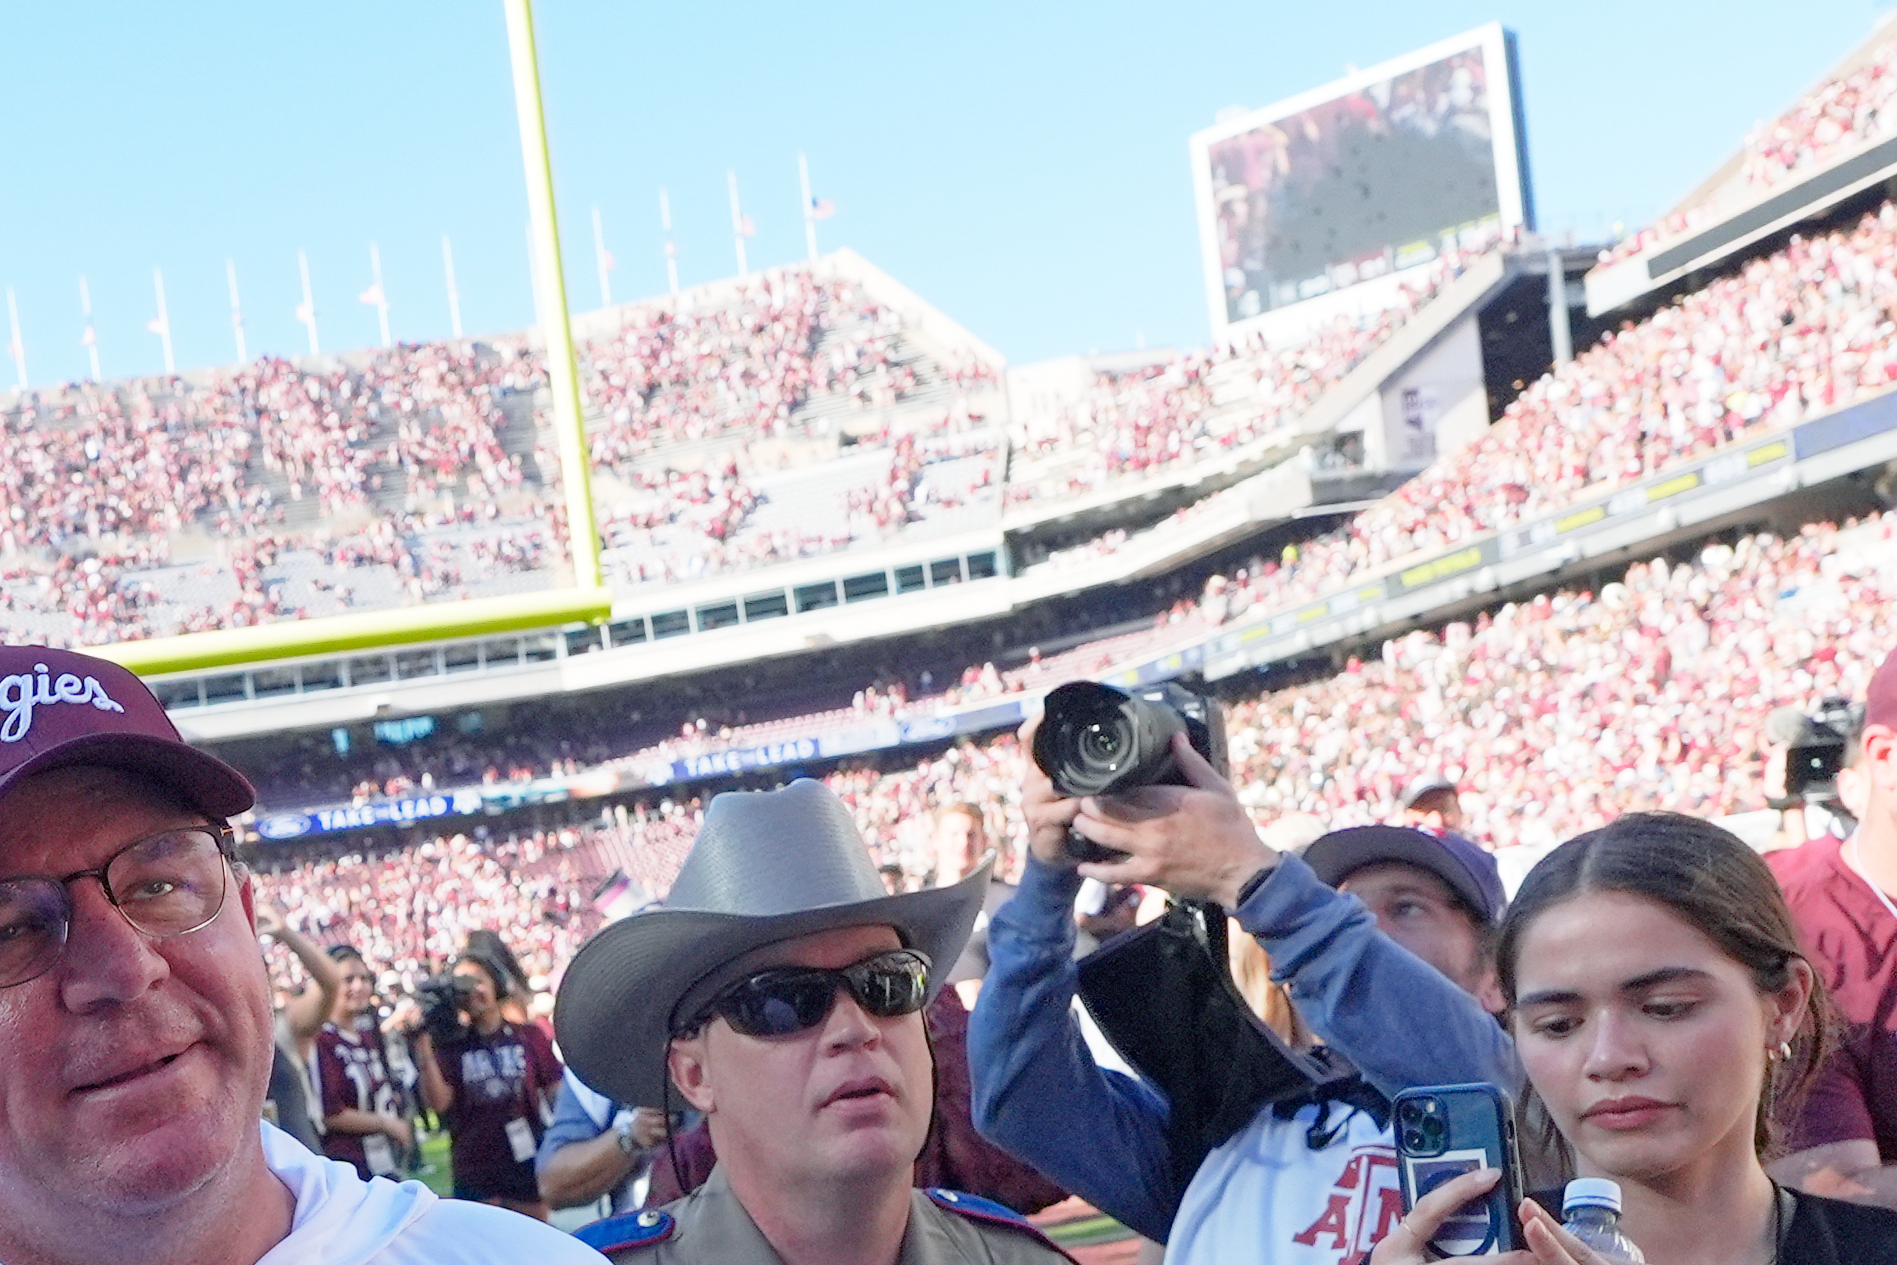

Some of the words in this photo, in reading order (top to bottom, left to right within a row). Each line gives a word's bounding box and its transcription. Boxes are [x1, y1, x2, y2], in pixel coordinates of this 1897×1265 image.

[685, 750, 742, 778] TAKE
[755, 737, 816, 765] LEAD
[317, 805, 377, 832] TAKE
[389, 796, 448, 822] LEAD
